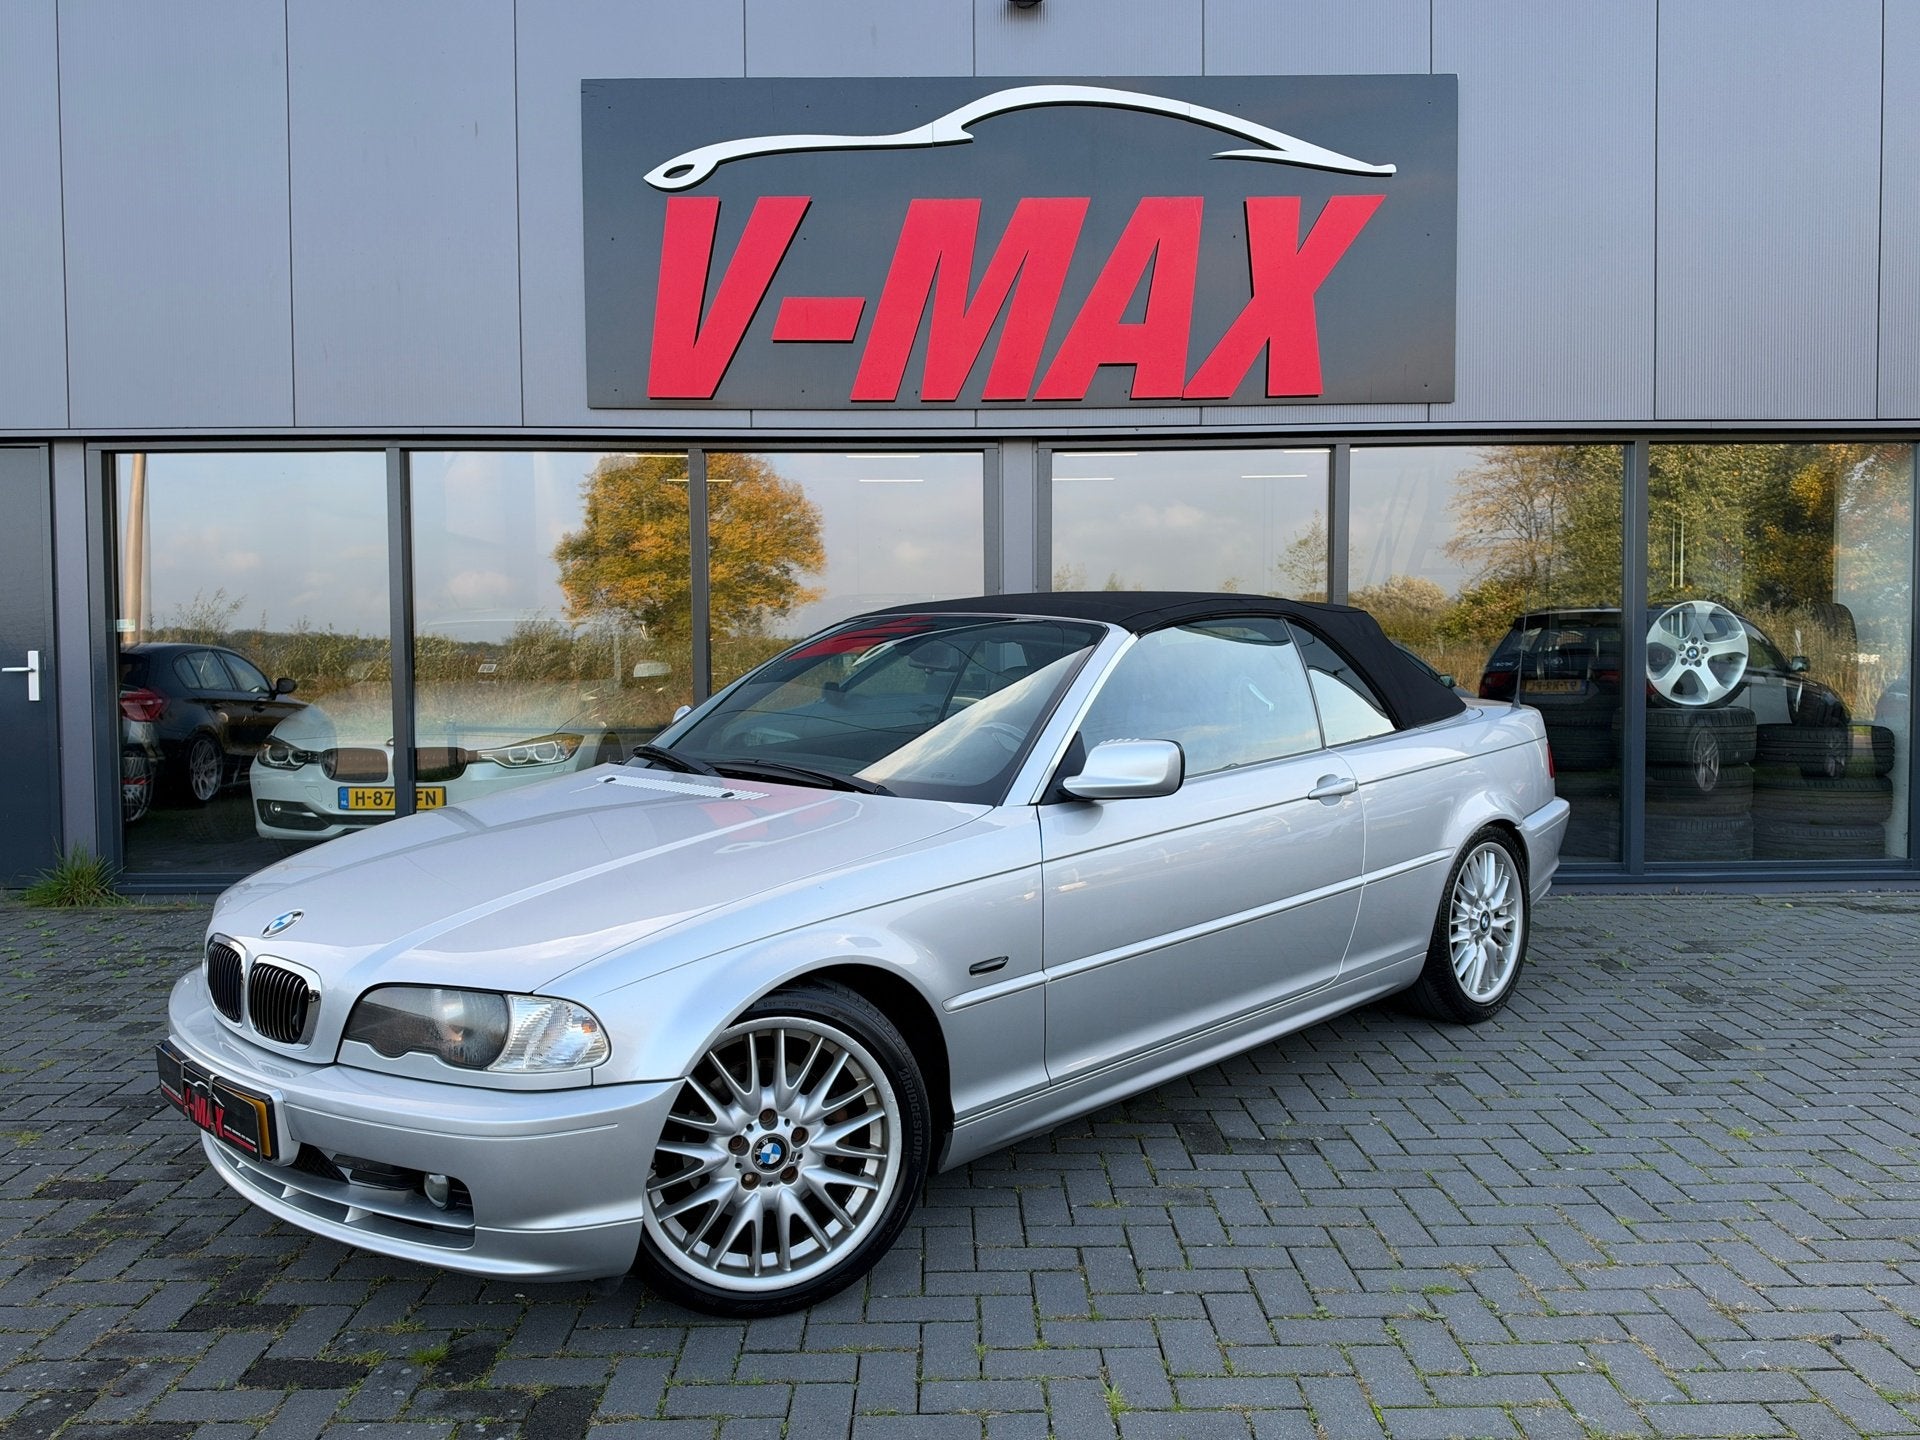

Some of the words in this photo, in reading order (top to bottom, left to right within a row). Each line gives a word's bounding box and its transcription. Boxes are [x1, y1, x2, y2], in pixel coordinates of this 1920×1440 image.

[646, 194, 1387, 402] V-MAX
[355, 790, 436, 806] H-87FN
[897, 1067, 923, 1163] BRIDGESTONE
